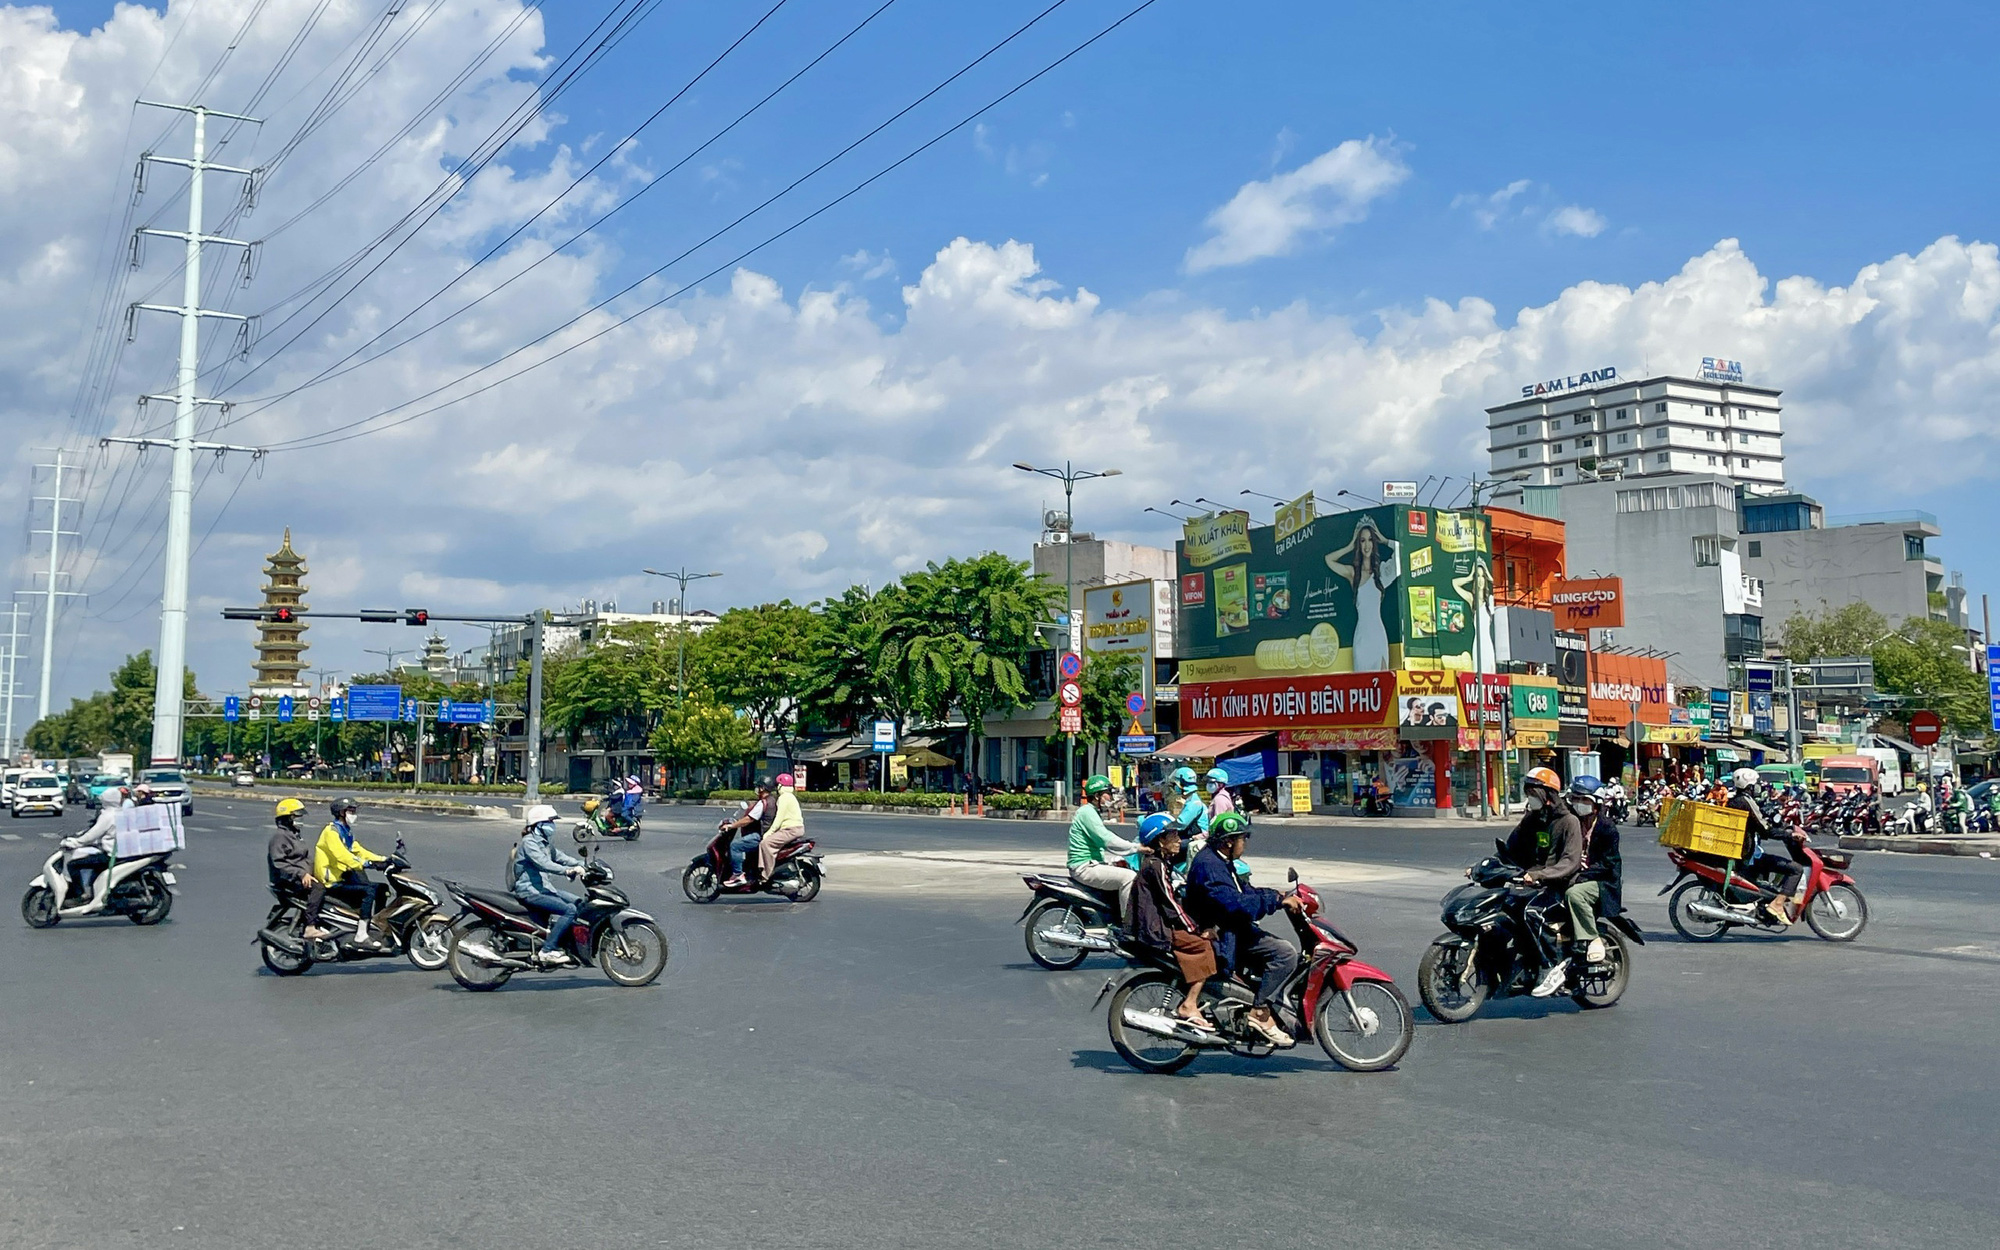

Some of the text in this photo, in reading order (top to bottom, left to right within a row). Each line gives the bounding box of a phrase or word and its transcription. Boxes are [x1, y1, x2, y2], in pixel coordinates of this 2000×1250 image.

[1703, 357, 1742, 374] SAM
[1522, 367, 1616, 398] SAM LAND
[1187, 532, 1197, 547] MÌ
[1198, 524, 1219, 547] XUẤT
[1221, 515, 1244, 537] KHẨU
[1184, 591, 1203, 601] VIFON
[1552, 590, 1616, 604] KINGFOOD
[1567, 604, 1601, 619] mart
[1186, 663, 1195, 676] 19
[1192, 686, 1218, 719] MẮT
[1222, 688, 1248, 718] KÍNH
[1252, 693, 1270, 717] BV
[1273, 686, 1306, 720] ĐIỆN
[1310, 684, 1344, 715] BIÊN
[1349, 677, 1381, 712] PHỦ
[1400, 686, 1429, 696] Luxury
[1591, 682, 1666, 704] KINGFOOD mart
